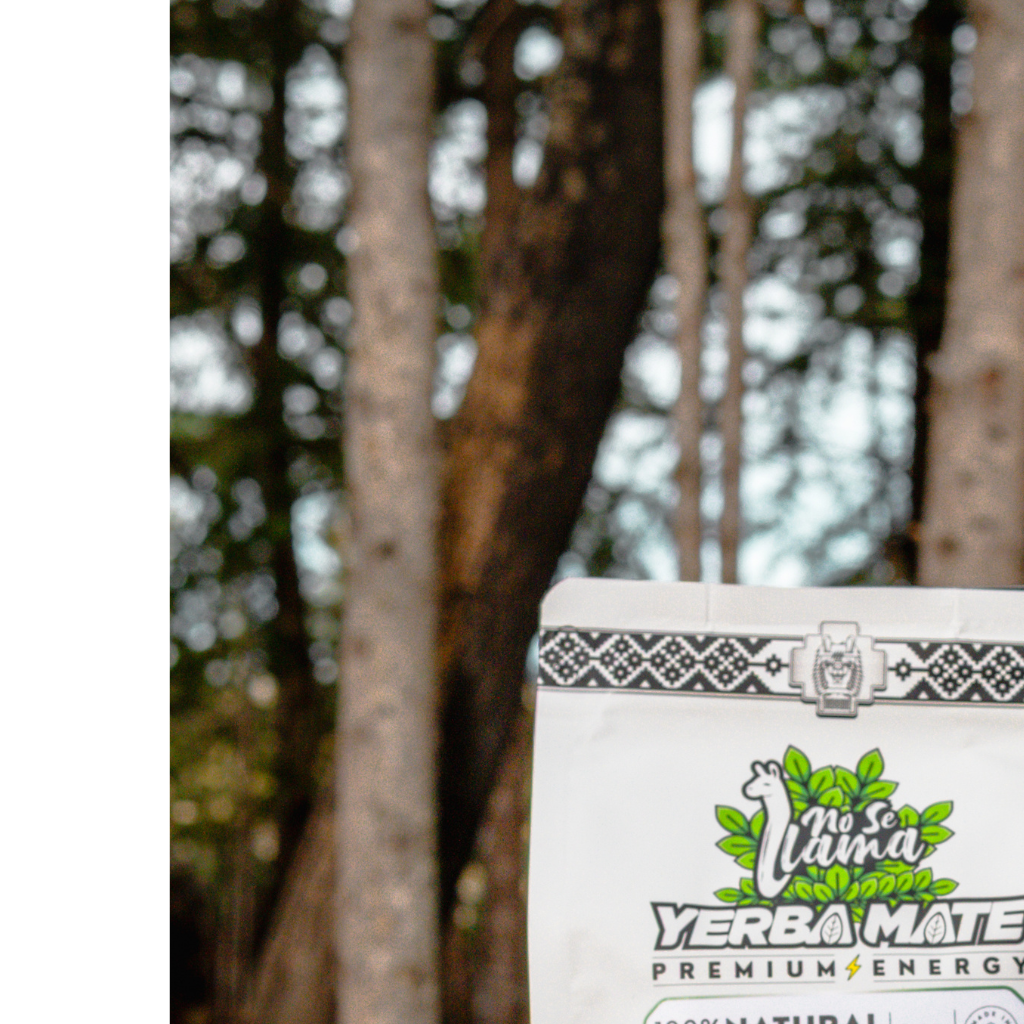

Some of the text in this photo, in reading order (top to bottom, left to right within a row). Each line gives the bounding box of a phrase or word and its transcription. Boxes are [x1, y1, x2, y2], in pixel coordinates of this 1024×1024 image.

[801, 806, 854, 838] No
[653, 902, 857, 949] YERBA
[652, 959, 836, 980] PREMIUM
